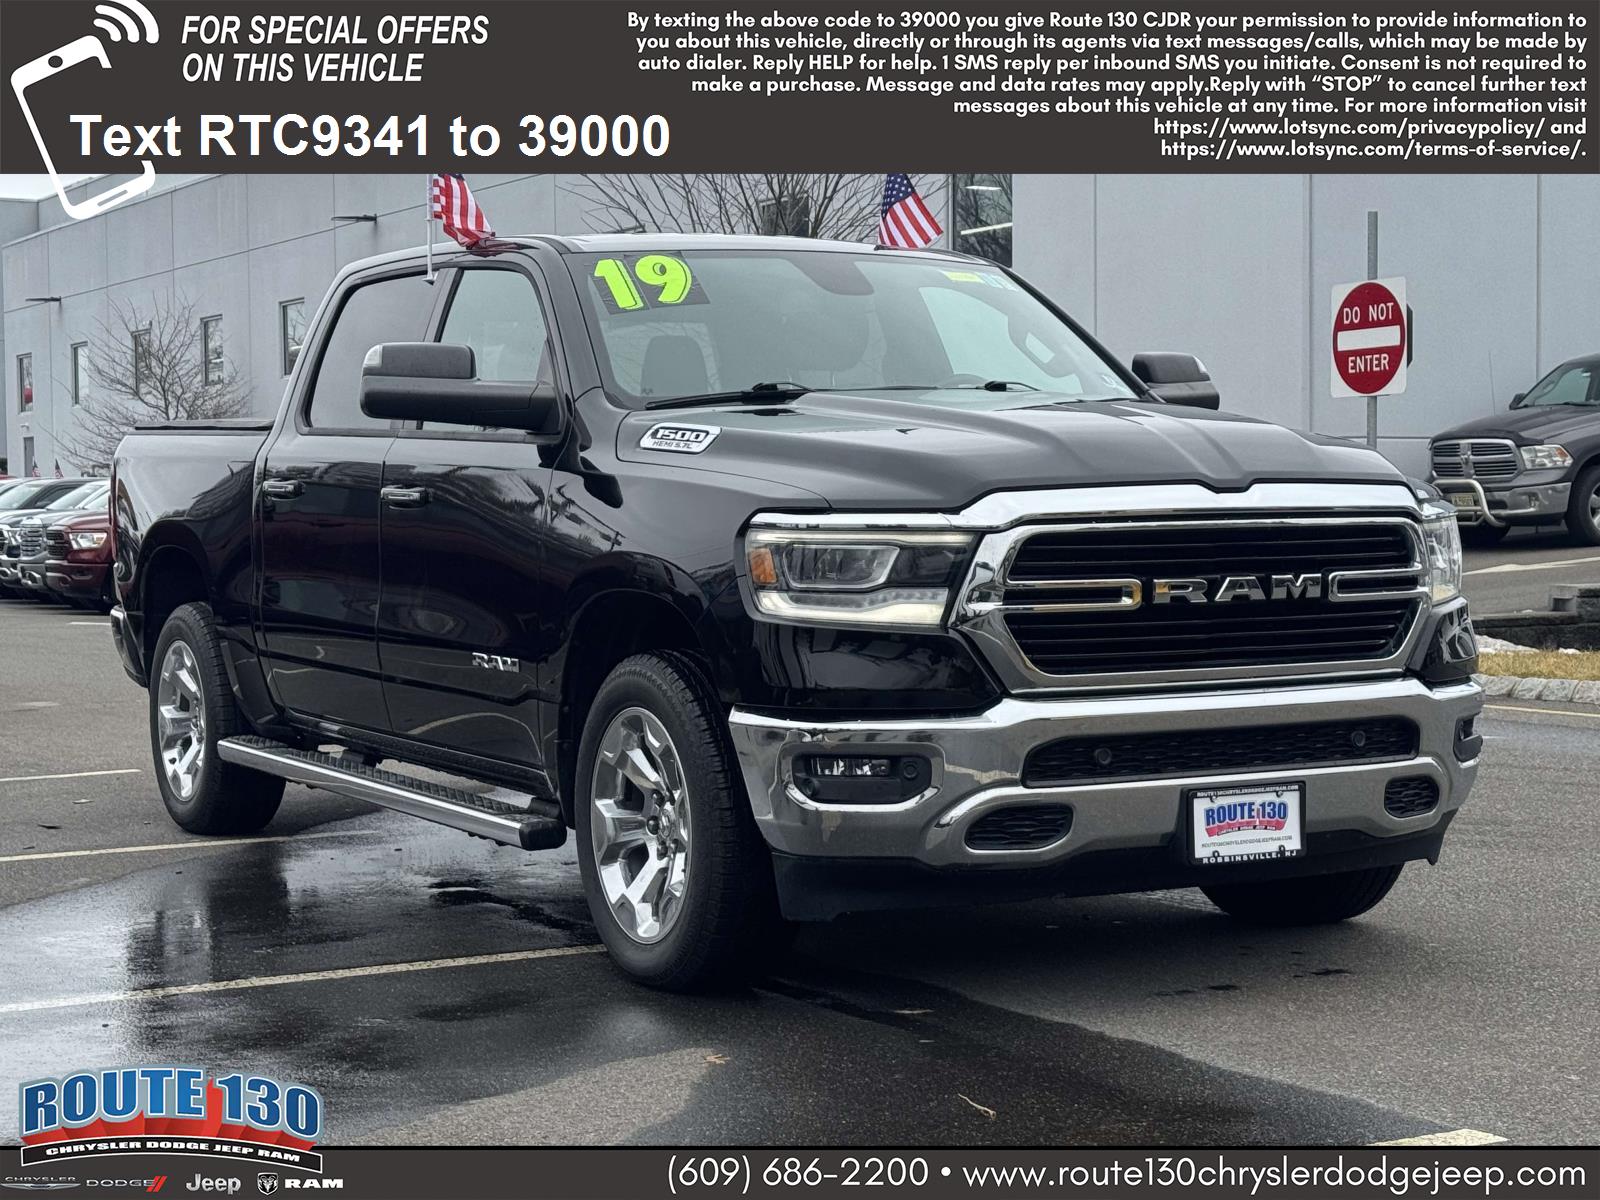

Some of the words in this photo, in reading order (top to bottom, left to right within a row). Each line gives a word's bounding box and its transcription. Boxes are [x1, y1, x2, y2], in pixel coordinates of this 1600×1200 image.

[594, 255, 692, 309] 19
[1343, 306, 1360, 324] DO
[1368, 302, 1394, 322] NOT
[1348, 353, 1389, 374] ENTER
[652, 440, 672, 448] HEMI
[656, 428, 707, 442] 1500
[1152, 573, 1322, 604] RAM
[472, 652, 519, 673] RAM
[1205, 801, 1255, 827] ROUTE
[1259, 801, 1288, 820] 130
